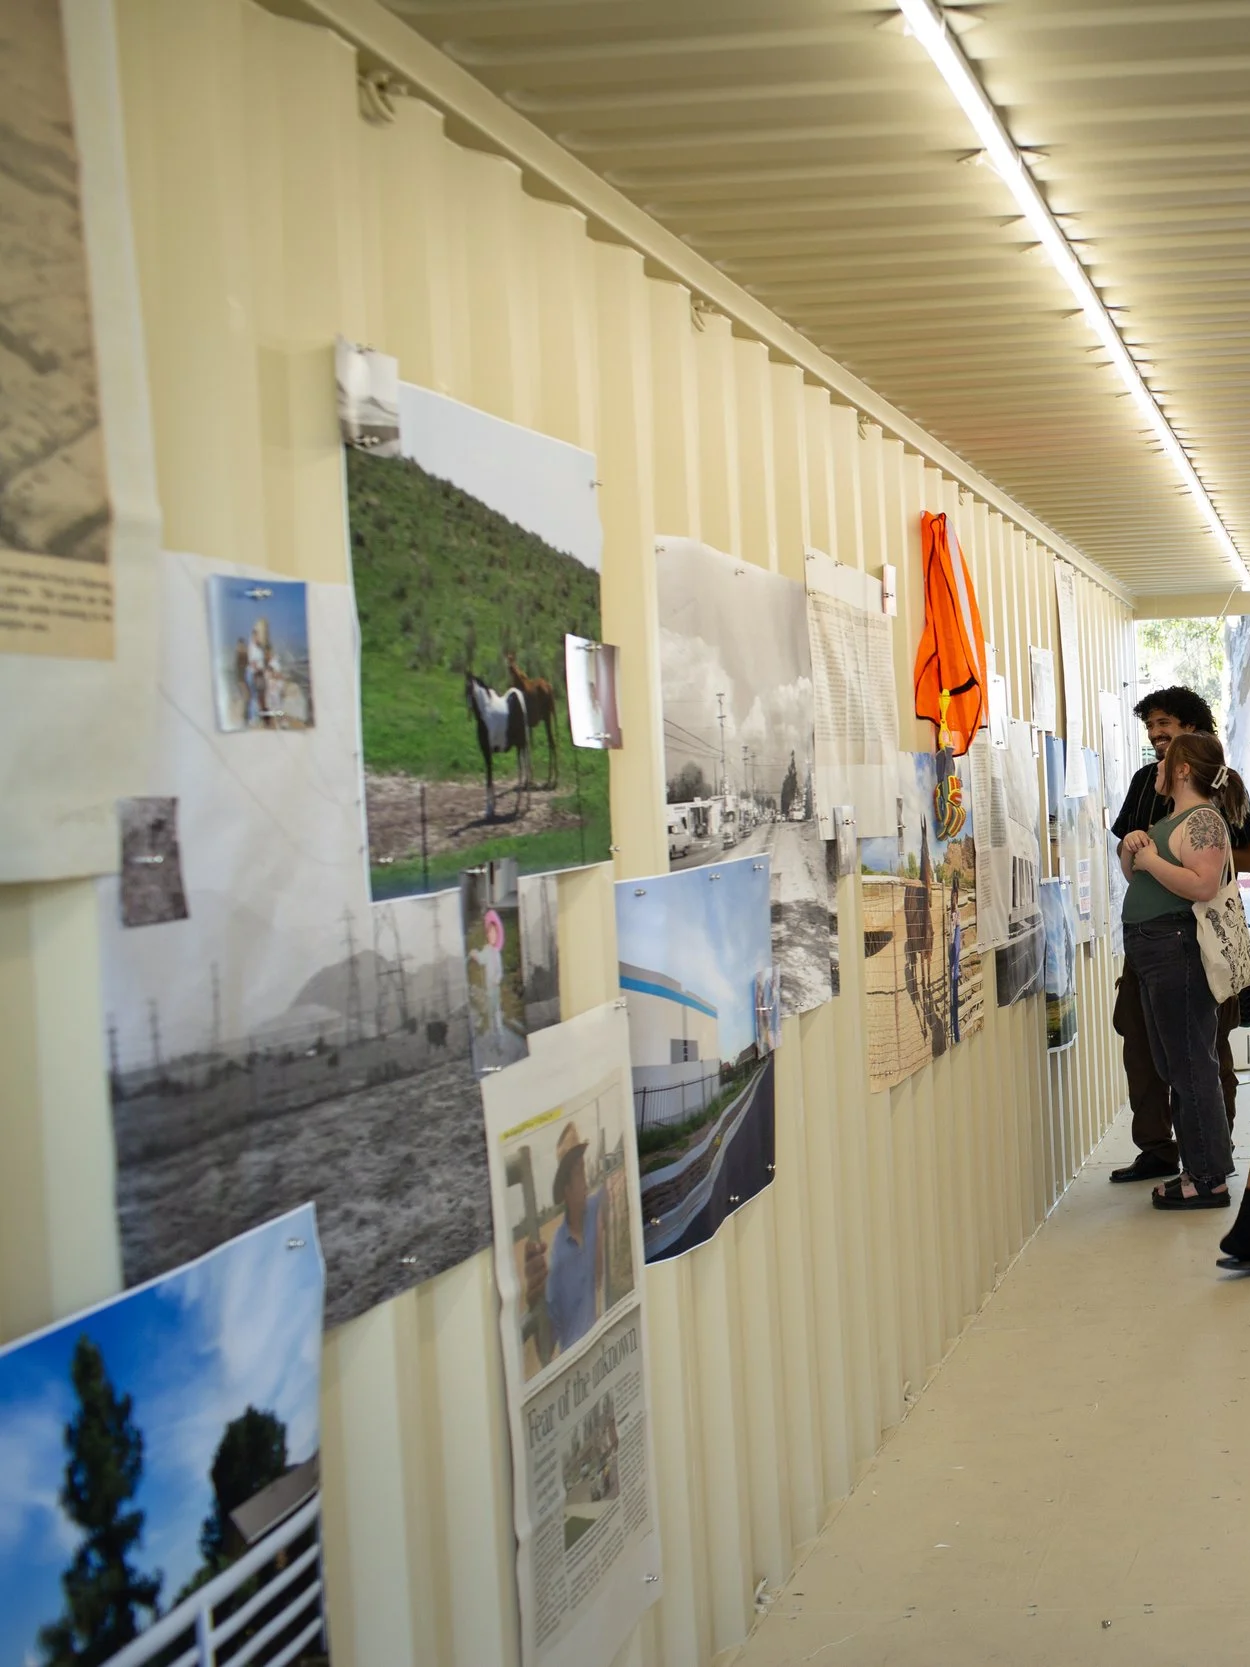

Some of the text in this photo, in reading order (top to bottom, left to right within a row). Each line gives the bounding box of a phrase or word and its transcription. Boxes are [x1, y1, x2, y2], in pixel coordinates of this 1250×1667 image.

[527, 1402, 555, 1449] Fear
[557, 1378, 571, 1421] of
[573, 1369, 590, 1409] the
[592, 1327, 638, 1389] unknown
